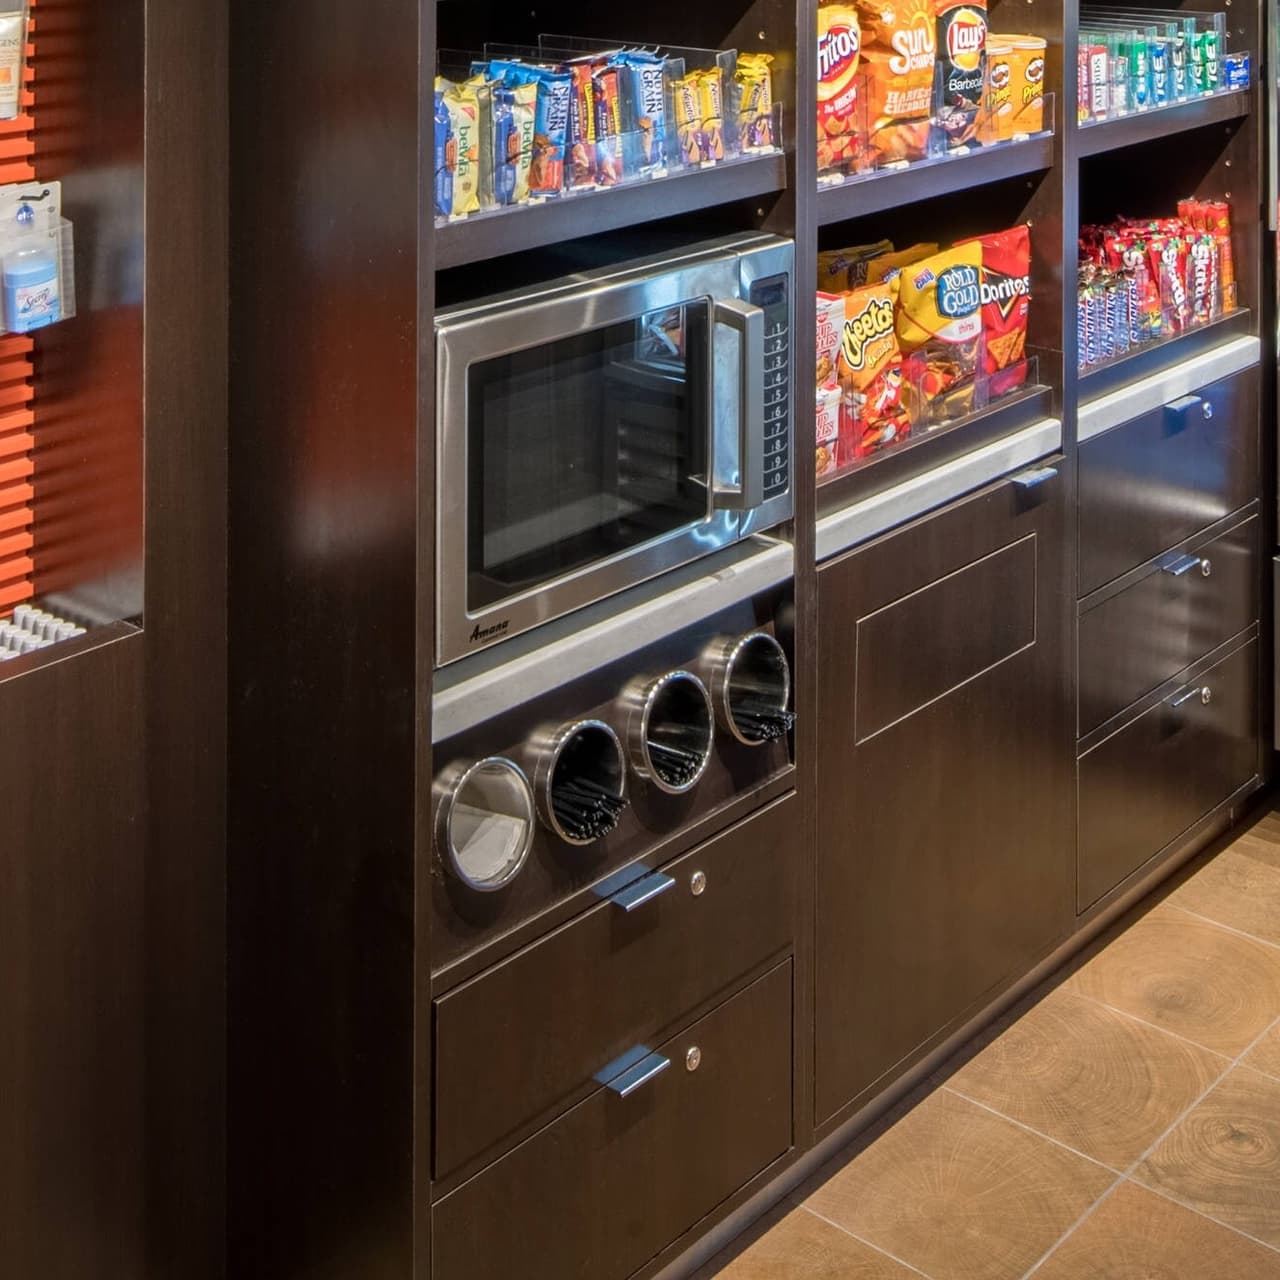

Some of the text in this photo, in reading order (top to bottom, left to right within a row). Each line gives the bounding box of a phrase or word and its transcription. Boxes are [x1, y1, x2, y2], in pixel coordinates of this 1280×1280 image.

[953, 22, 985, 53] Lay's
[643, 70, 656, 113] GRAIN
[944, 267, 976, 292] ROLD
[981, 276, 1029, 305] Doritos
[943, 288, 980, 314] GOLD
[776, 323, 780, 333] 1
[842, 298, 894, 370] Cheetos
[776, 340, 781, 350] 2
[776, 357, 781, 367] 3
[776, 373, 781, 383] 4
[776, 389, 781, 400] 5
[775, 406, 781, 417] 6
[776, 423, 781, 433] 7
[775, 440, 781, 449] 8
[775, 456, 781, 466] 9
[775, 472, 781, 483] 0
[470, 620, 511, 643] Amana
